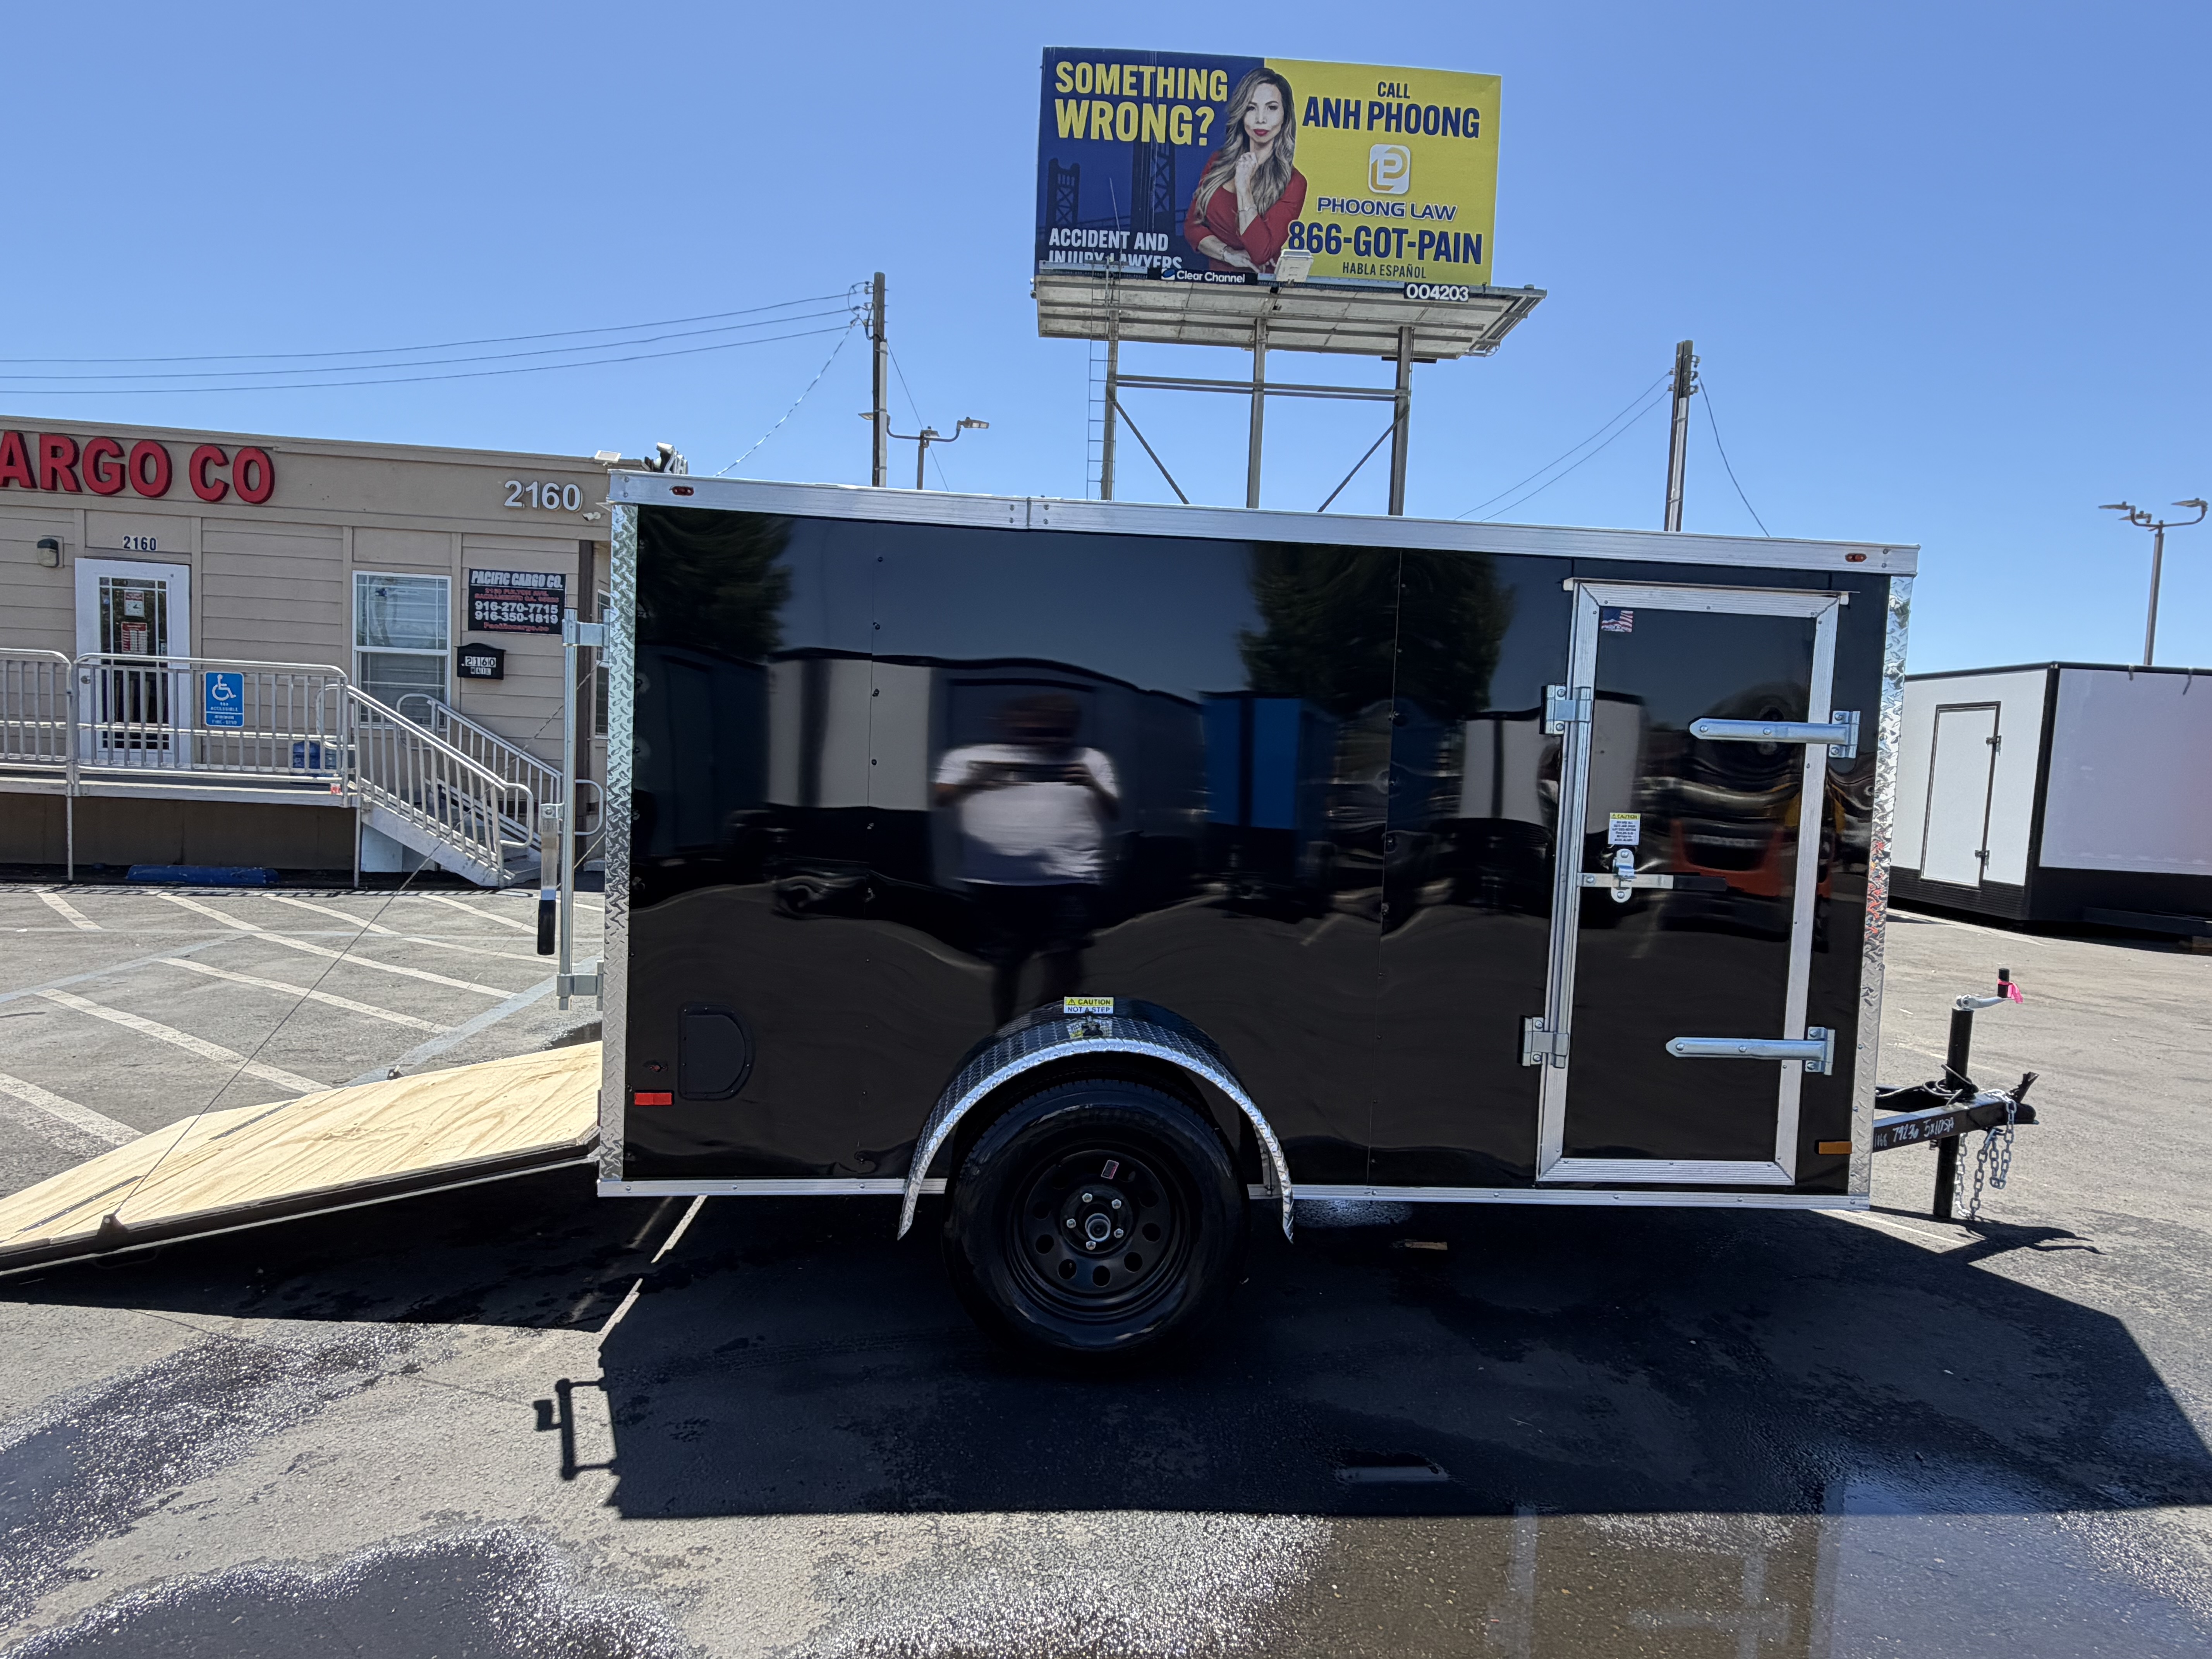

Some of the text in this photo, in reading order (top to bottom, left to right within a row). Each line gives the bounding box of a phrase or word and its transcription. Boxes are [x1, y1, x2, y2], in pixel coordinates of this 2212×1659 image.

[1055, 61, 1228, 101] SOMETHING
[1378, 82, 1410, 98] CALL
[1055, 99, 1214, 146] WRONG?
[1302, 96, 1479, 138] ANH PHOONG
[1317, 197, 1456, 220] PHOONG LAW
[1049, 228, 1169, 251] ACCIDENT AND
[1288, 222, 1482, 265] 866-GOT-PAIN
[1176, 271, 1245, 283] Clear Channel
[1343, 262, 1427, 278] HABLA ESPAÑOL
[1406, 284, 1468, 301] 004203
[0, 431, 275, 503] ARGO CO
[504, 480, 582, 511] 2160
[124, 536, 156, 551] 2160
[471, 571, 563, 587] PACIFIC CARGO CO.
[475, 601, 558, 614] 916-270-7715
[475, 610, 558, 624] 916-350-1819
[467, 658, 495, 666] 2160
